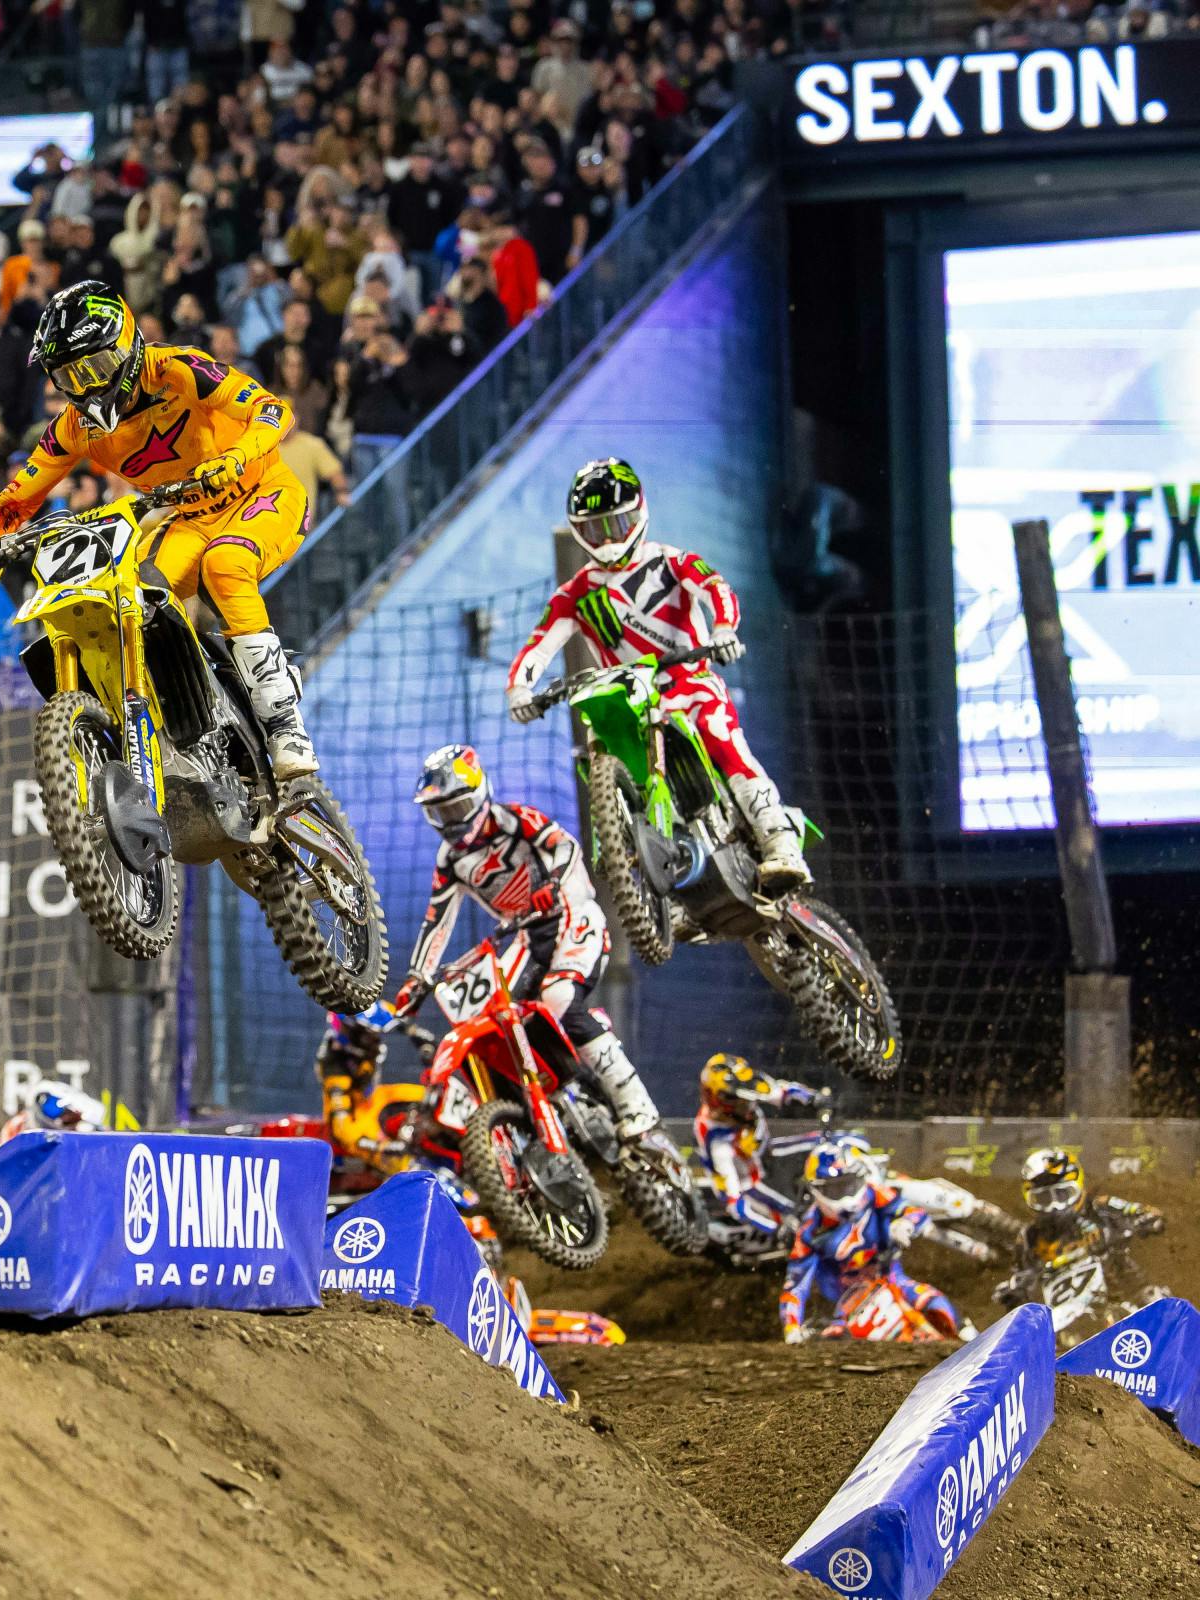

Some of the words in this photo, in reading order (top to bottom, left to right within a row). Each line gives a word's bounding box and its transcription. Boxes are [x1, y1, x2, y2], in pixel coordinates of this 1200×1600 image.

[795, 44, 1168, 146] SEXTON.
[48, 525, 118, 585] 21
[623, 611, 677, 650] Kawasak
[159, 1152, 285, 1250] YAMAHA
[135, 1263, 276, 1287] RACING
[959, 1370, 1028, 1521] YAMAHA
[943, 1451, 1022, 1570] RACING
